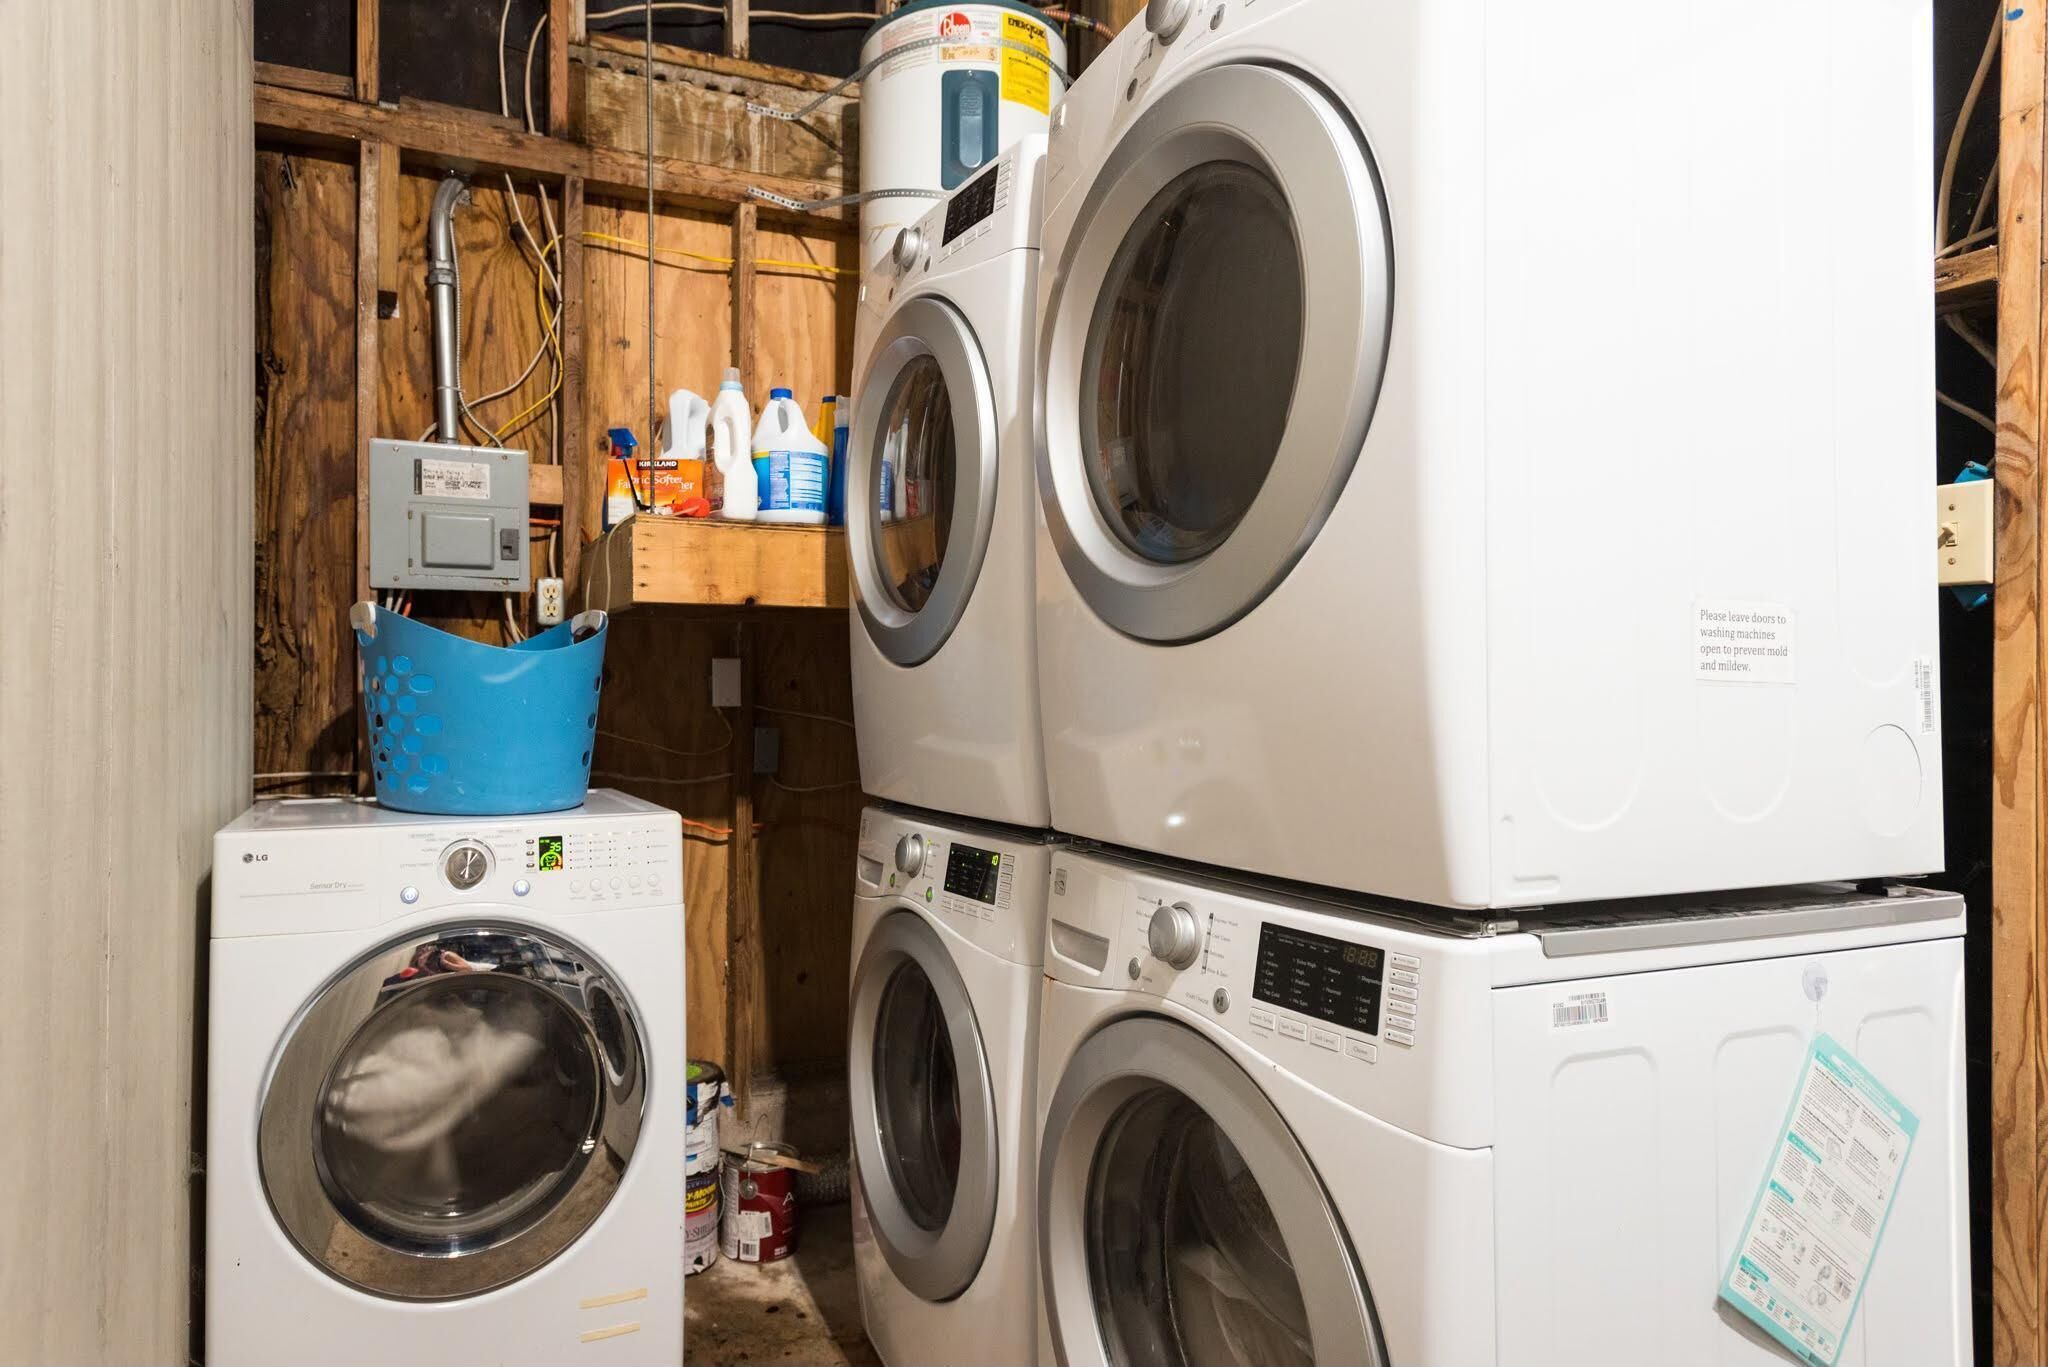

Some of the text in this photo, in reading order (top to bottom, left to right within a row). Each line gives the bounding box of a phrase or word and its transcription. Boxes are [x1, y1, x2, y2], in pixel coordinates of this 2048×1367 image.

[1700, 609, 1787, 624] Please leave doors to
[1700, 627, 1776, 641] washing machines
[1700, 645, 1788, 657] open to prevent mold
[1700, 659, 1751, 671] and mildew.
